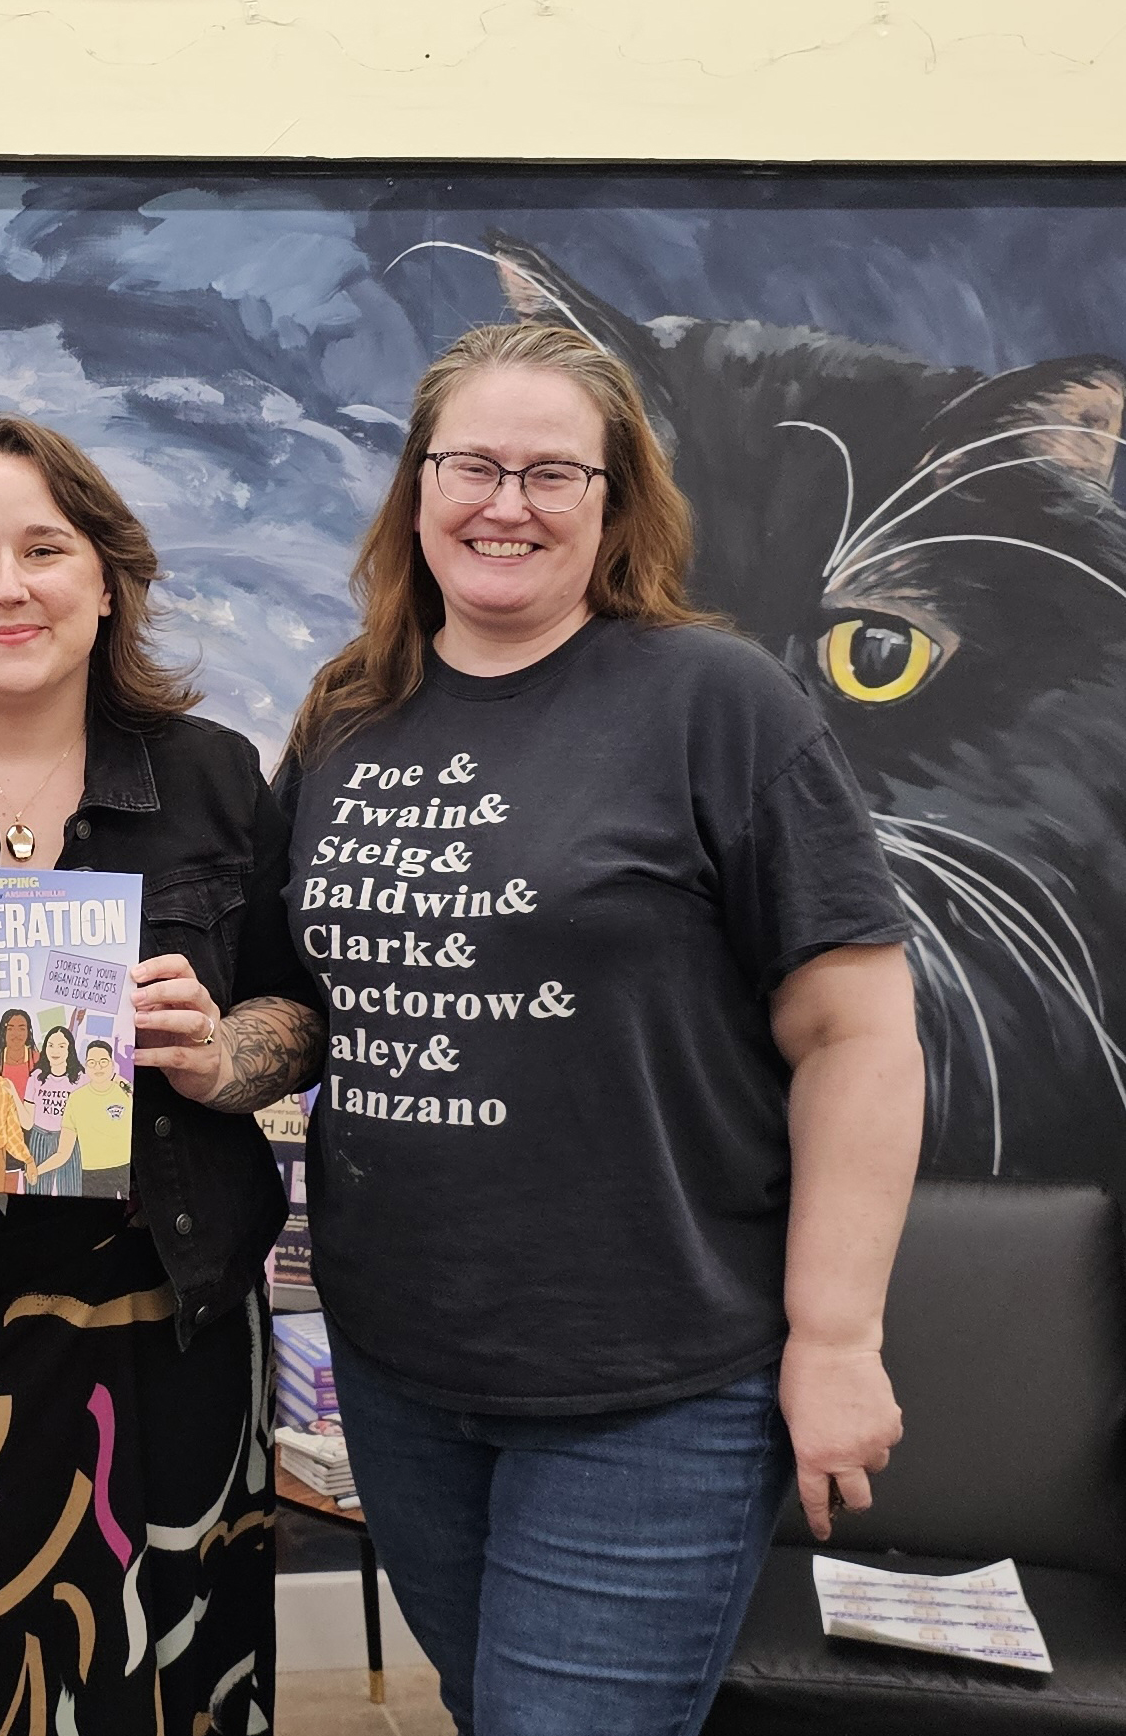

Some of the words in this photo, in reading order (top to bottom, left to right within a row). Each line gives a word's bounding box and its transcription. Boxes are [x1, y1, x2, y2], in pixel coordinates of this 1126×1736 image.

[343, 763, 424, 789] Poe
[438, 752, 478, 785] &
[55, 960, 81, 973] STORIES
[84, 965, 93, 975] OF
[96, 967, 117, 980] YOUTH
[55, 985, 69, 997] AND
[72, 988, 107, 1005] EDUCATORS
[318, 972, 576, 1020] octorow&
[331, 1028, 460, 1078] aley&
[37, 1089, 71, 1098] PROTECT
[42, 1098, 67, 1107] TRANS
[43, 1106, 64, 1116] KIDS
